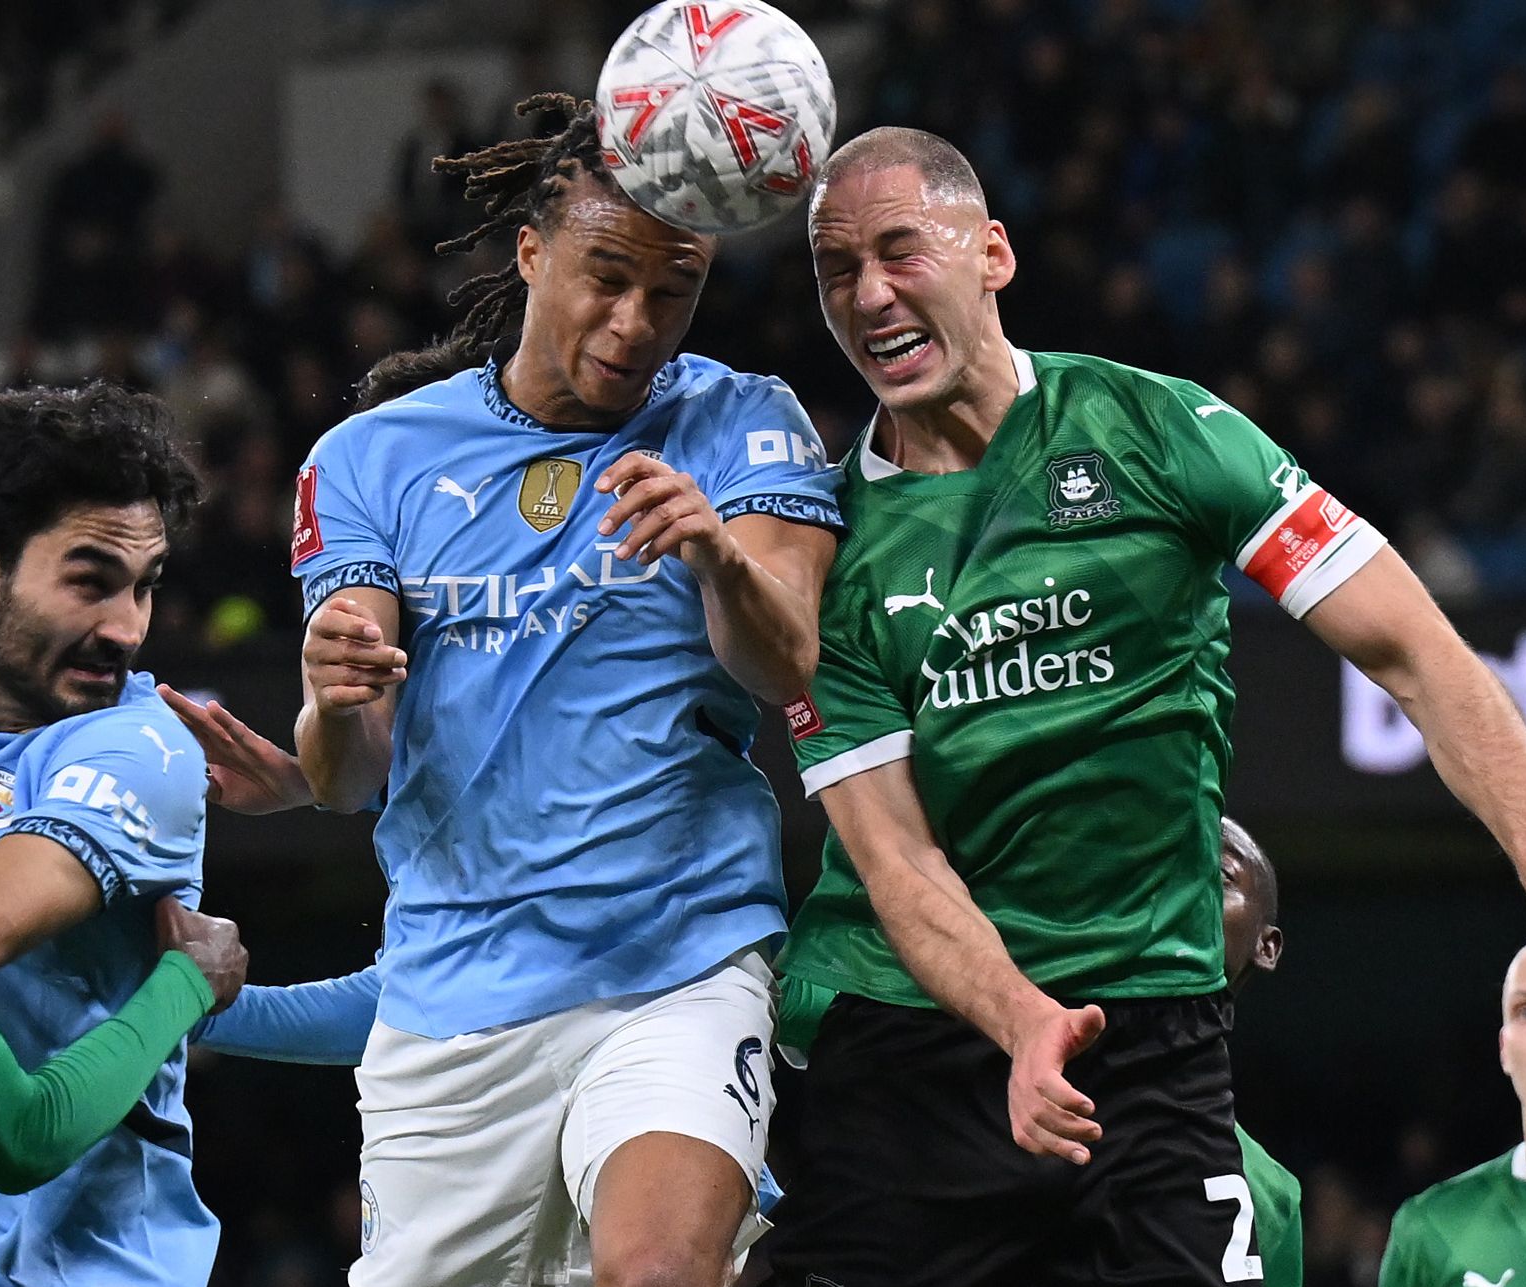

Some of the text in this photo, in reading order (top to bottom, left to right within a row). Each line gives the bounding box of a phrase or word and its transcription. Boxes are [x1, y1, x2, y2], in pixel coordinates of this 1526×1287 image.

[532, 504, 560, 515] FIFA
[295, 528, 312, 547] CUP
[1302, 542, 1320, 561] CUP
[442, 603, 589, 655] AIRAYS
[922, 641, 1115, 710] uilders
[795, 710, 812, 727] CUP
